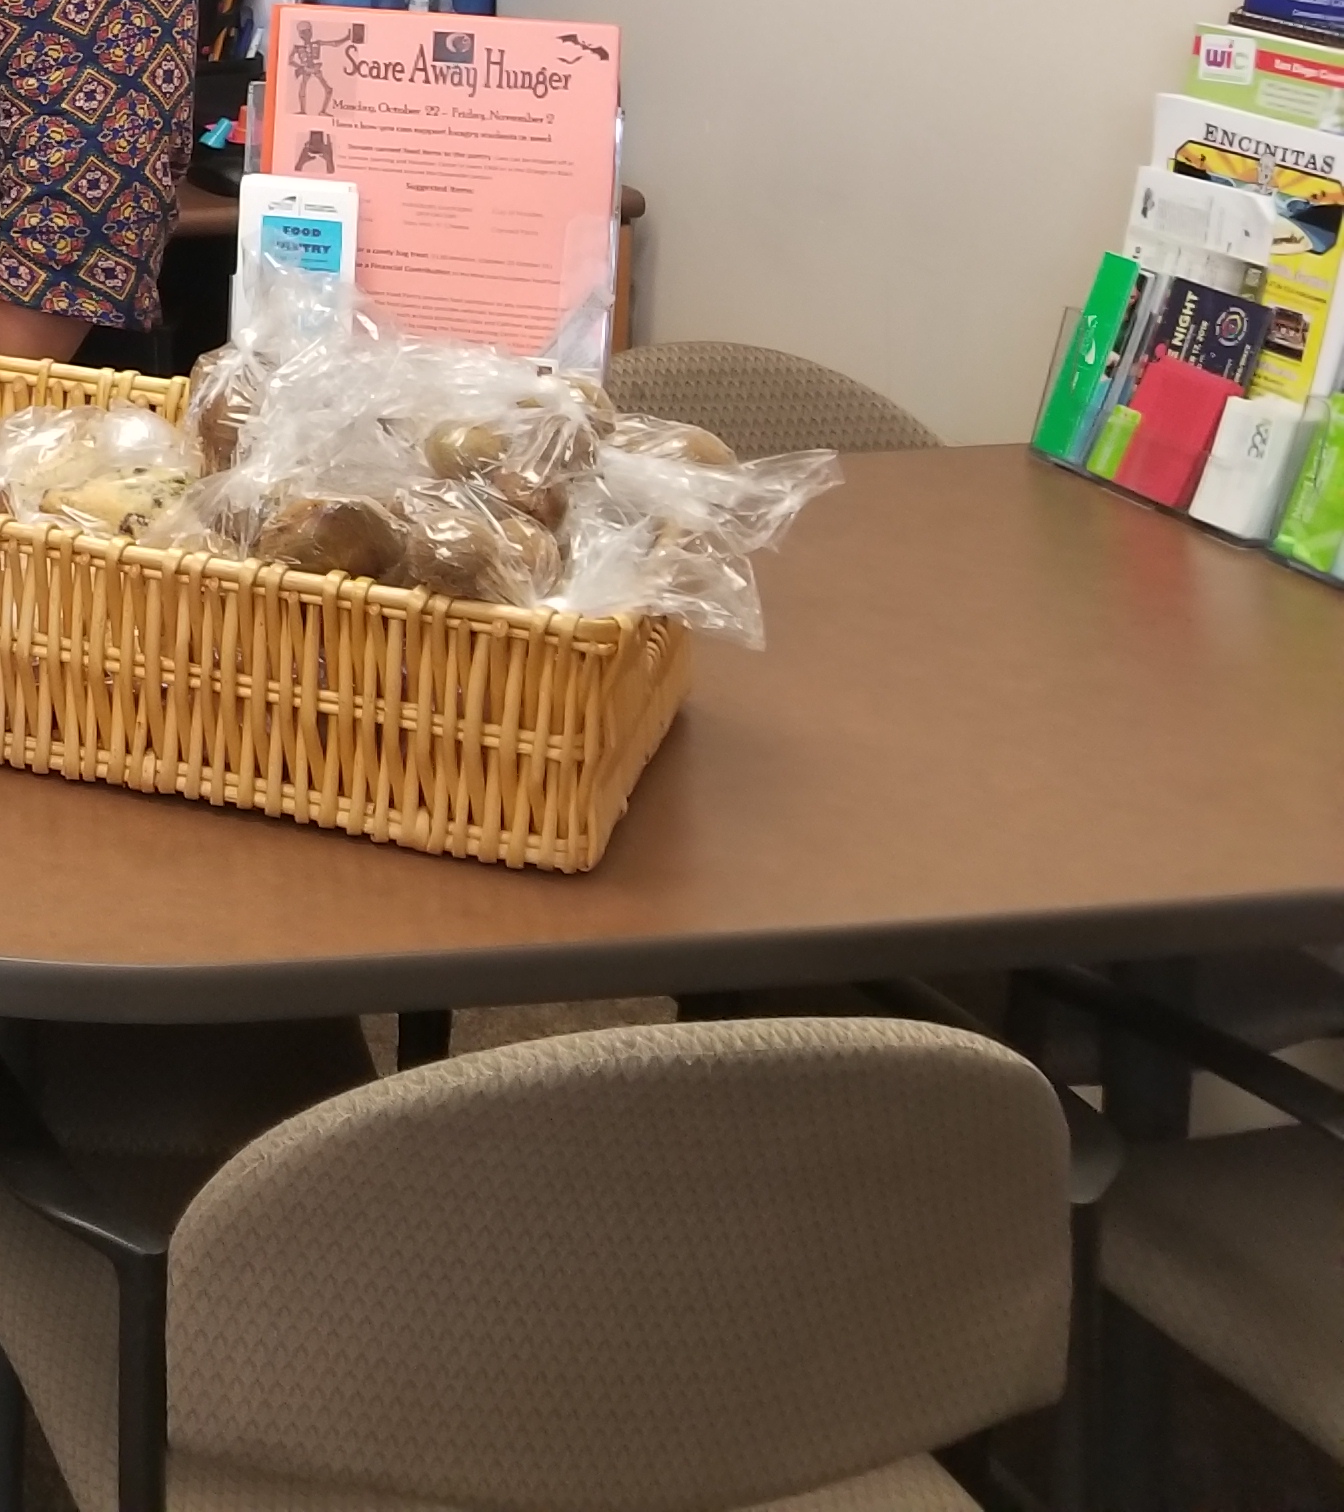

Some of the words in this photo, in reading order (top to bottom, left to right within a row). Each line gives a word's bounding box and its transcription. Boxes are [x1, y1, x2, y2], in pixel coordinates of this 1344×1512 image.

[343, 44, 406, 82] Scare
[408, 44, 478, 97] Away
[484, 47, 572, 99] Hunger
[331, 99, 377, 114] Monday,
[378, 102, 422, 115] October
[425, 105, 441, 117] 22
[451, 107, 487, 122] Friday,
[489, 110, 544, 124] November
[546, 113, 555, 125] 2
[1202, 122, 1335, 175] ENCINITAS
[282, 226, 321, 238] FOOD
[1171, 289, 1200, 347] NIGHT
